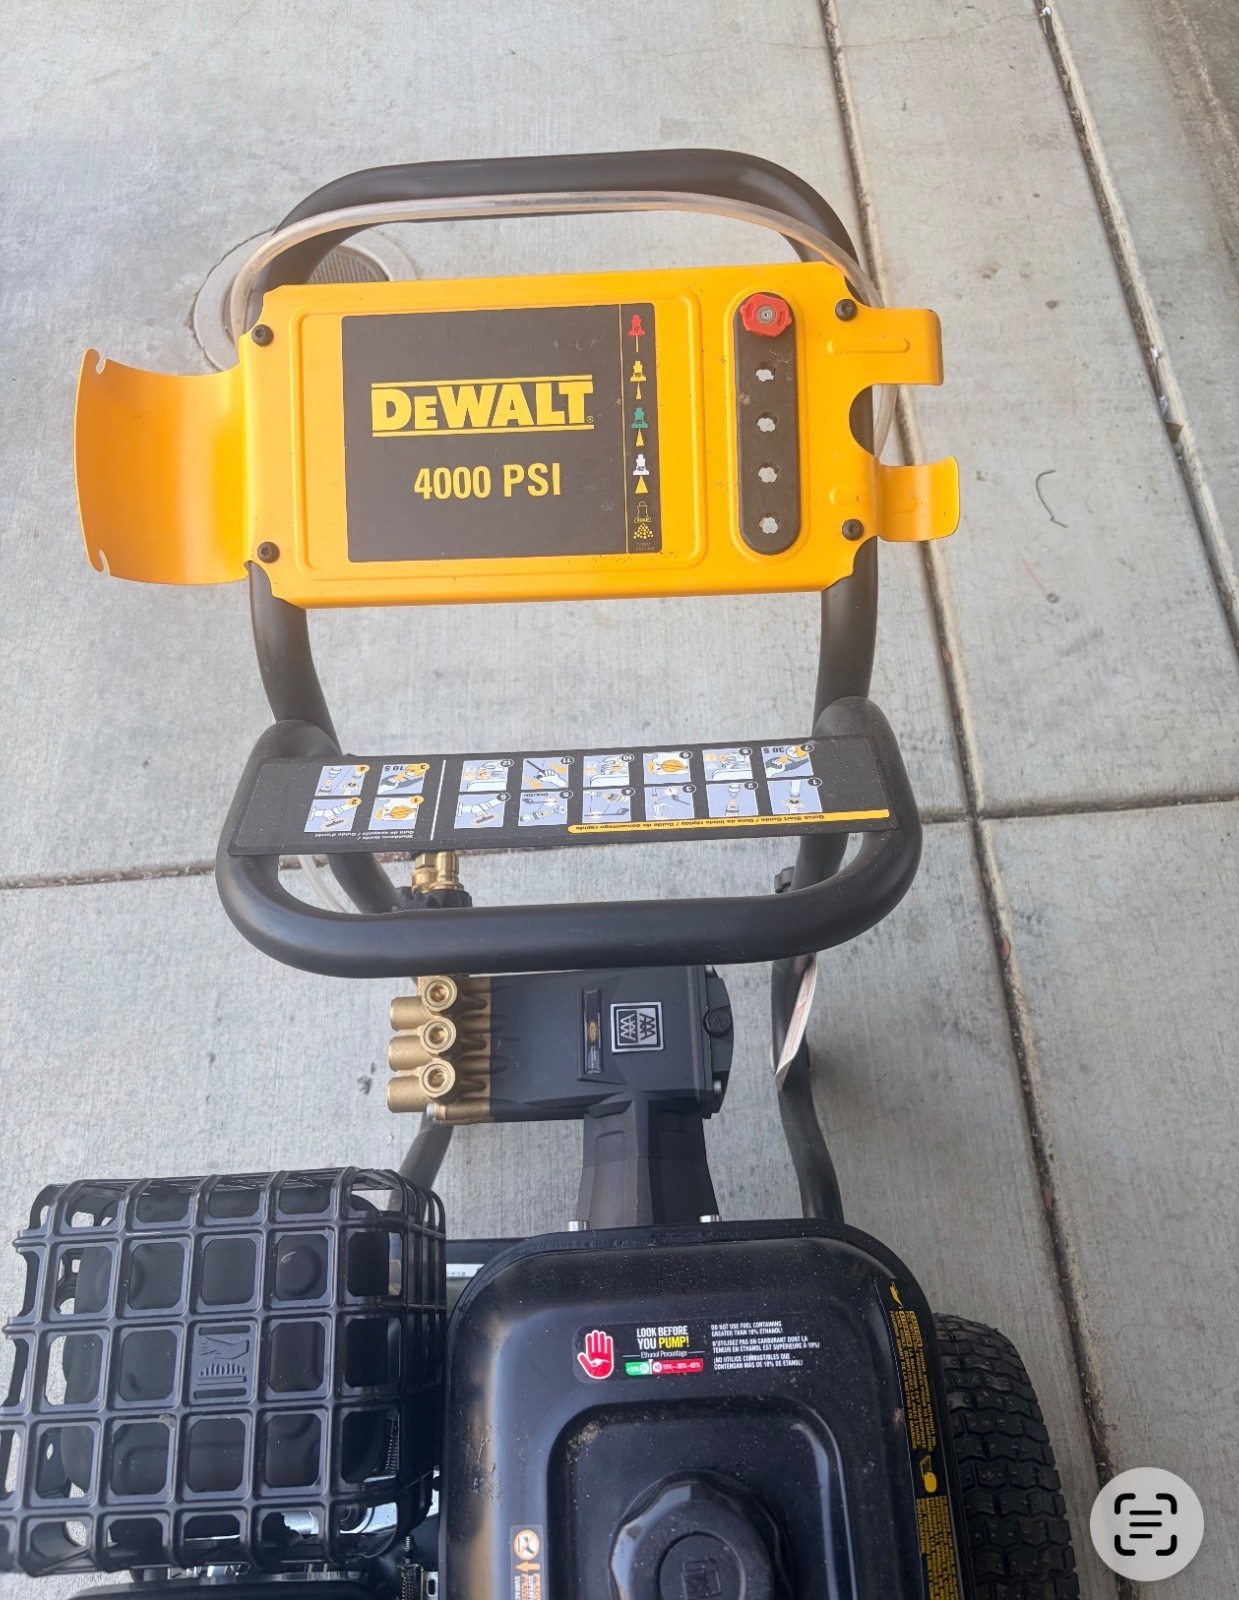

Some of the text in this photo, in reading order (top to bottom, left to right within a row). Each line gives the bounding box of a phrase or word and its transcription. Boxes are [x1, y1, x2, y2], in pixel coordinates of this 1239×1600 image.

[414, 462, 561, 500] 4000 PSI
[636, 1325, 688, 1338] LOOK BEFORE
[637, 1336, 690, 1350] YOU PUMP!
